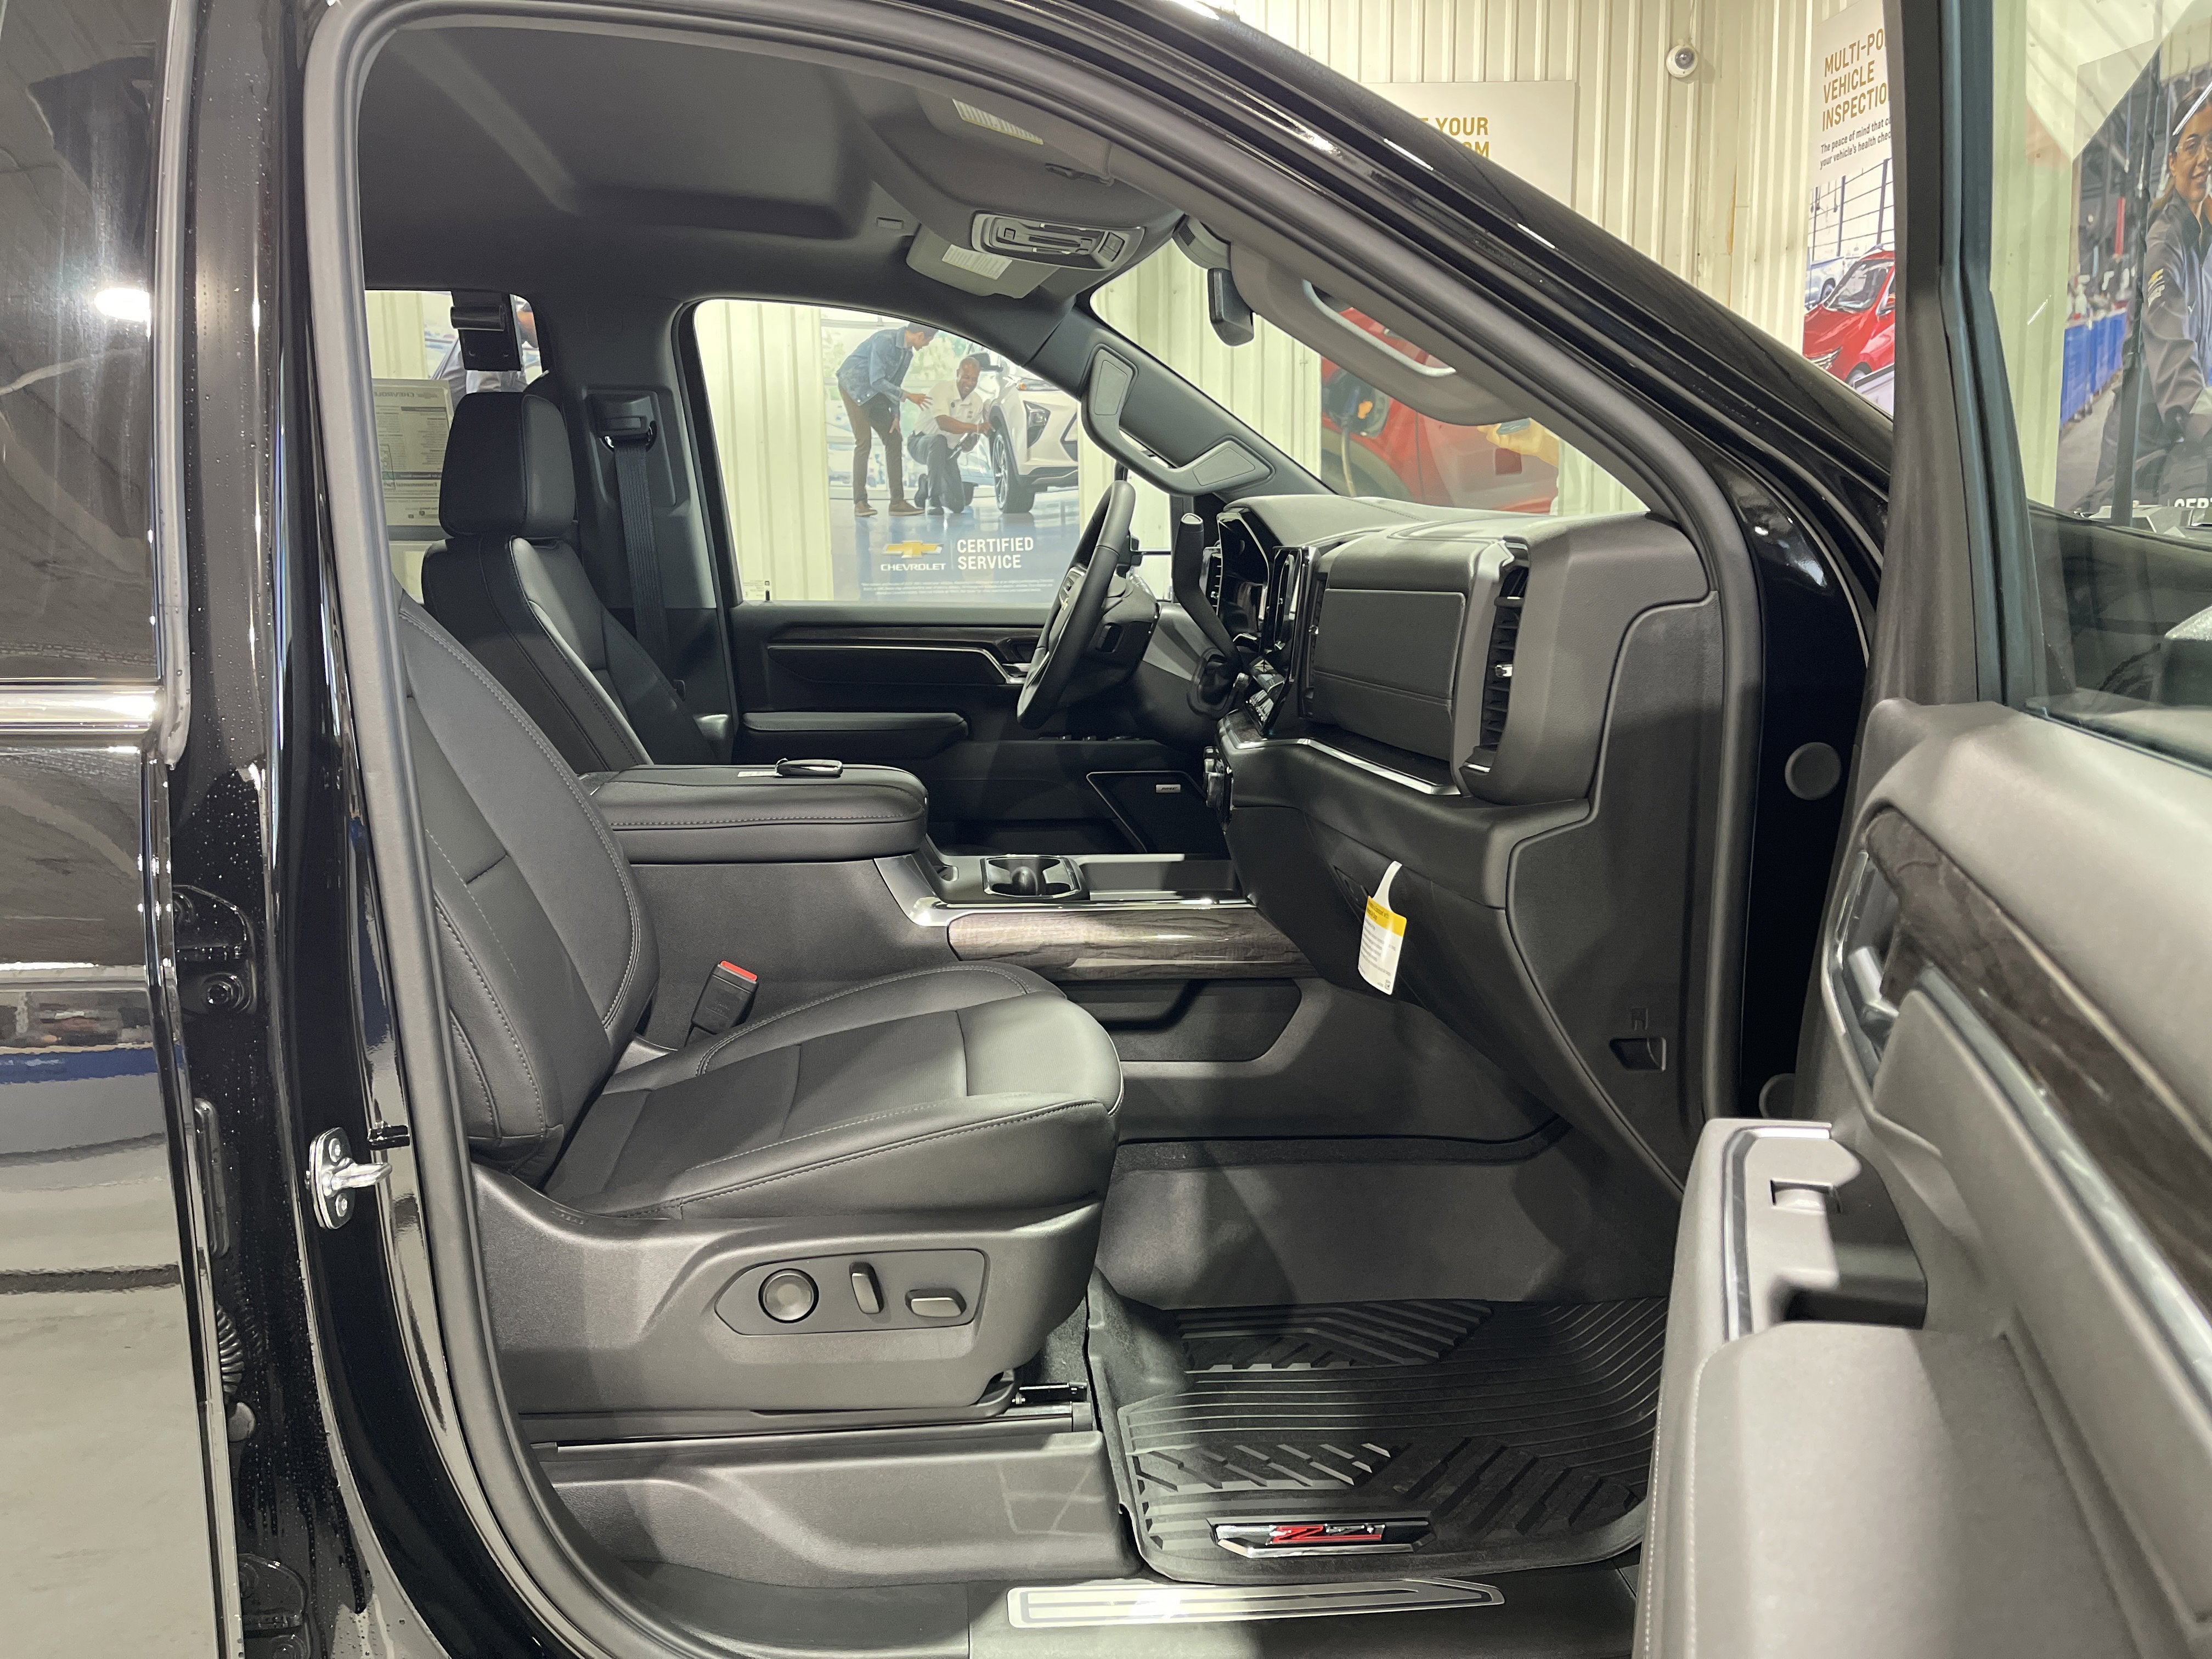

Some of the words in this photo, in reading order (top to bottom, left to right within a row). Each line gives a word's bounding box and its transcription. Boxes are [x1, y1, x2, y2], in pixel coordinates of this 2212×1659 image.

[1825, 28, 1883, 77] MULTI-PO
[1824, 59, 1875, 104] VEHICLE
[1822, 82, 1887, 132] INSPECTIO
[1435, 117, 1488, 136] YOUR
[1821, 143, 1831, 154] The
[1831, 136, 1848, 152] peace
[1849, 129, 1855, 142] of
[1856, 123, 1870, 139] mind
[1871, 118, 1884, 132] that
[1819, 156, 1832, 171] your
[1833, 144, 1857, 161] vehicle's
[1858, 136, 1876, 152] health
[2174, 497, 2212, 509] CER
[957, 537, 1034, 554] CERTIFIED
[880, 563, 946, 571] CHEVROLET
[957, 554, 1022, 570] SERVICE
